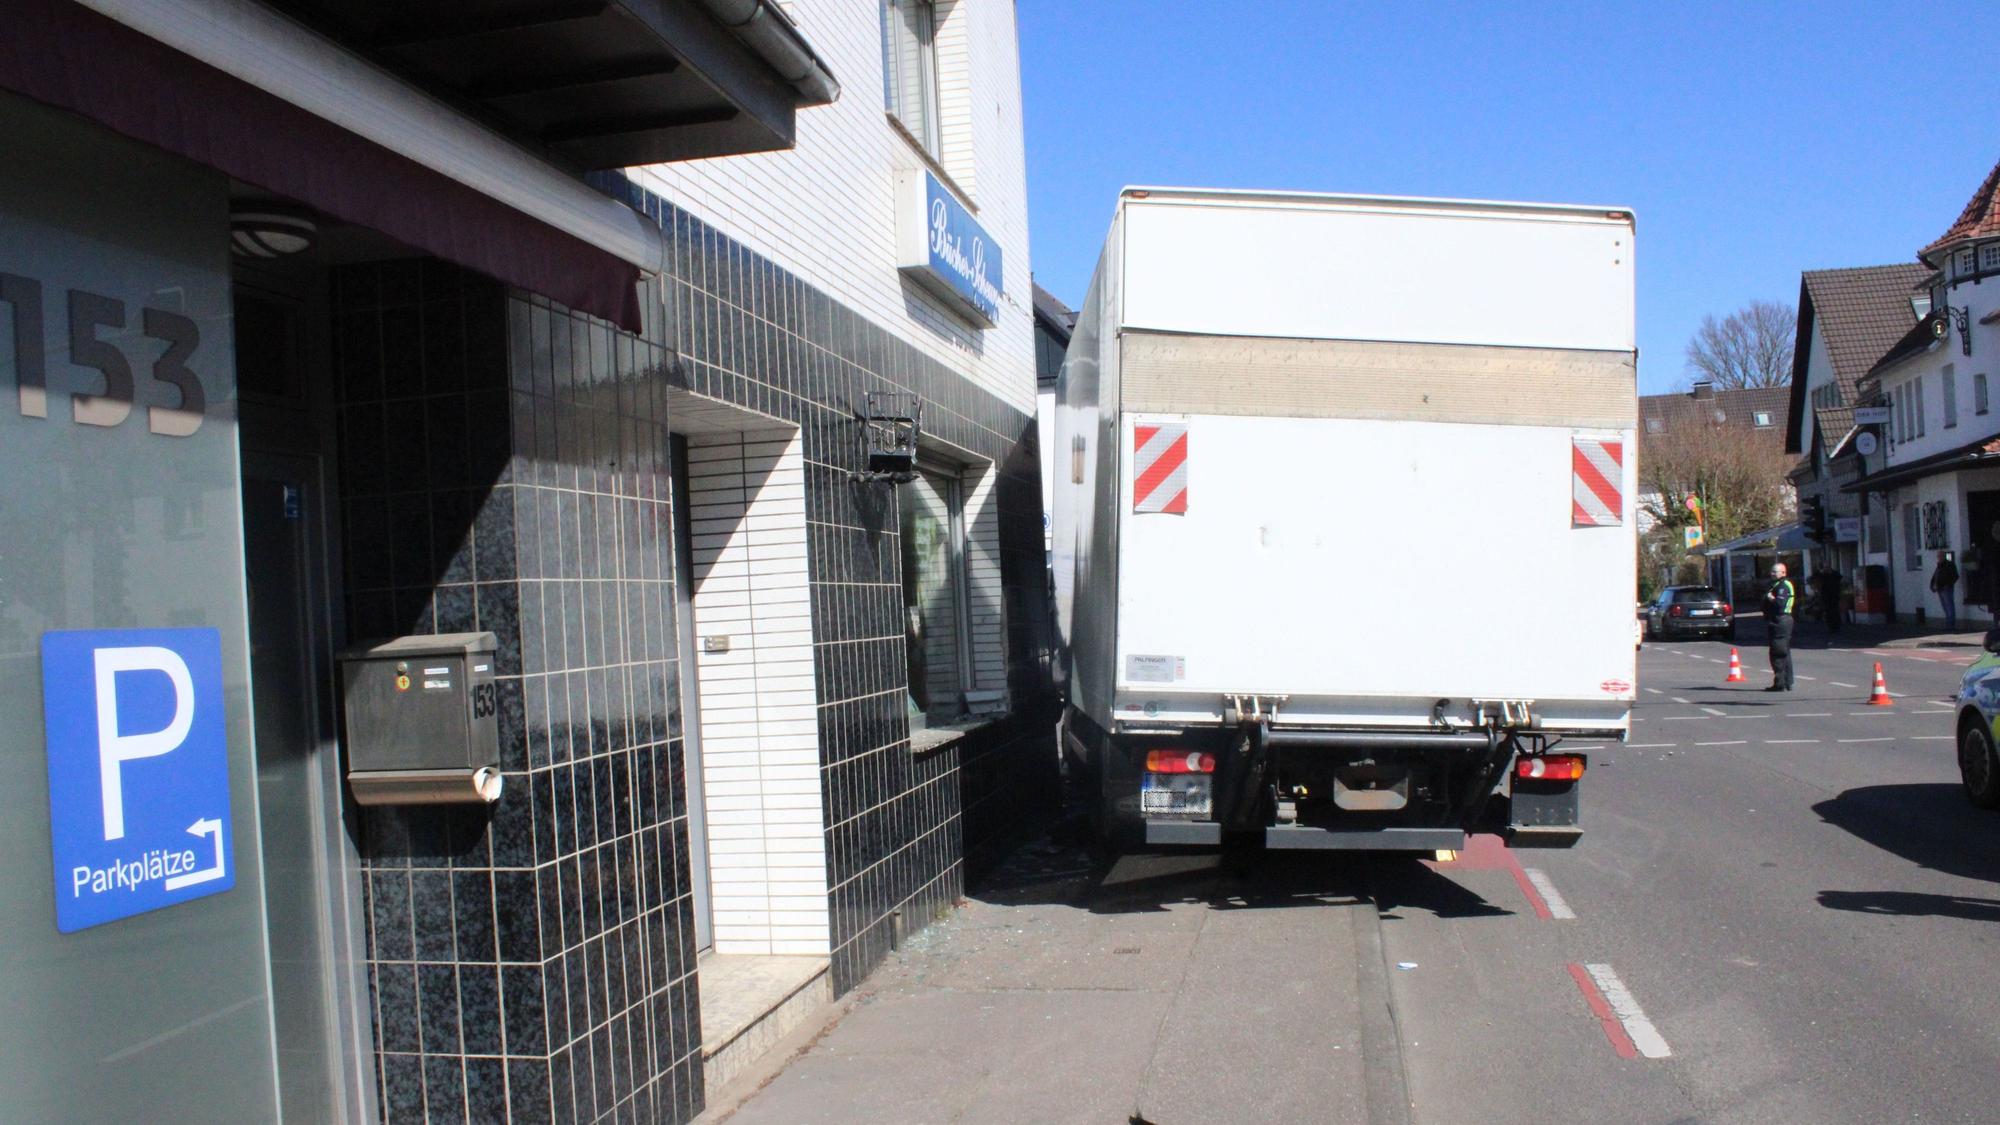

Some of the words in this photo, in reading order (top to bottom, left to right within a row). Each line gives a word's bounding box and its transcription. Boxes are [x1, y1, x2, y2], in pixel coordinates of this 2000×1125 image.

[0, 272, 206, 437] 153
[94, 646, 195, 841] P
[473, 683, 496, 720] 153
[72, 849, 196, 898] Parkplätze
